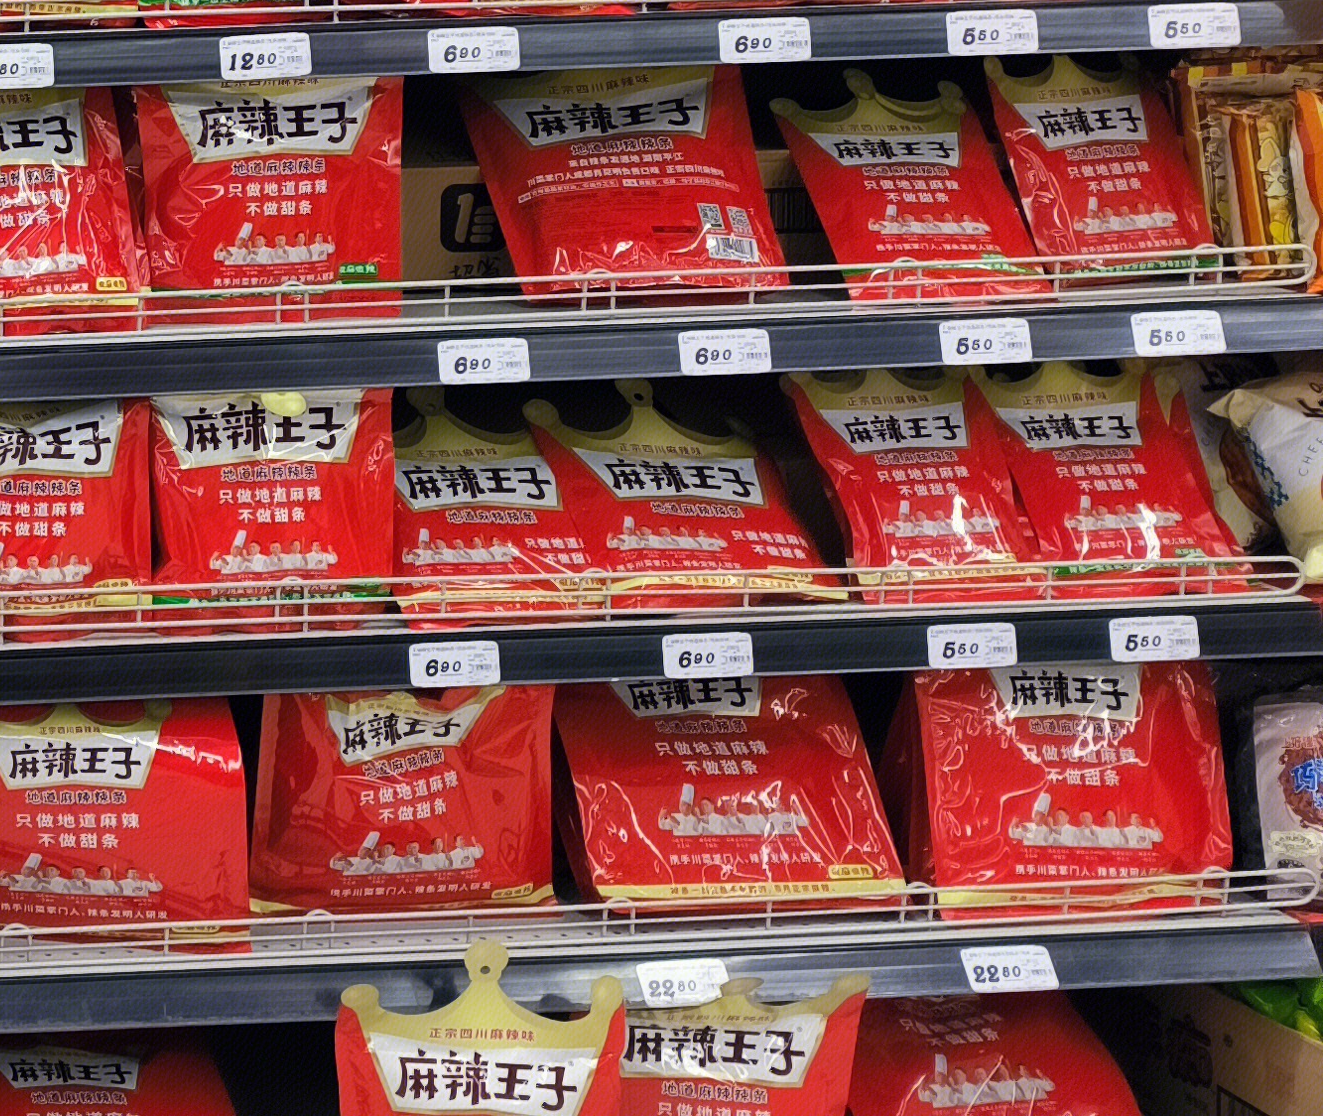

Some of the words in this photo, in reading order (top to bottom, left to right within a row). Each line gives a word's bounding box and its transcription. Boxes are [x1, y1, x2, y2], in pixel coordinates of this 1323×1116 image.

[526, 89, 701, 139] 麻辣王子
[1037, 103, 1143, 141] 麻辣王子
[832, 133, 959, 168] 麻辣王子
[842, 415, 963, 448] 麻辣王子
[404, 463, 552, 503] 麻辣王子
[611, 458, 755, 499] 麻辣王子
[341, 710, 462, 756] 麻辣王子
[8, 741, 143, 780] 麻辣王子
[15, 811, 141, 831] 只做地道麻辣
[38, 831, 121, 850] 不做甜条
[622, 1023, 807, 1077] 麻辣王子
[393, 1050, 580, 1111] 麻辣王子
